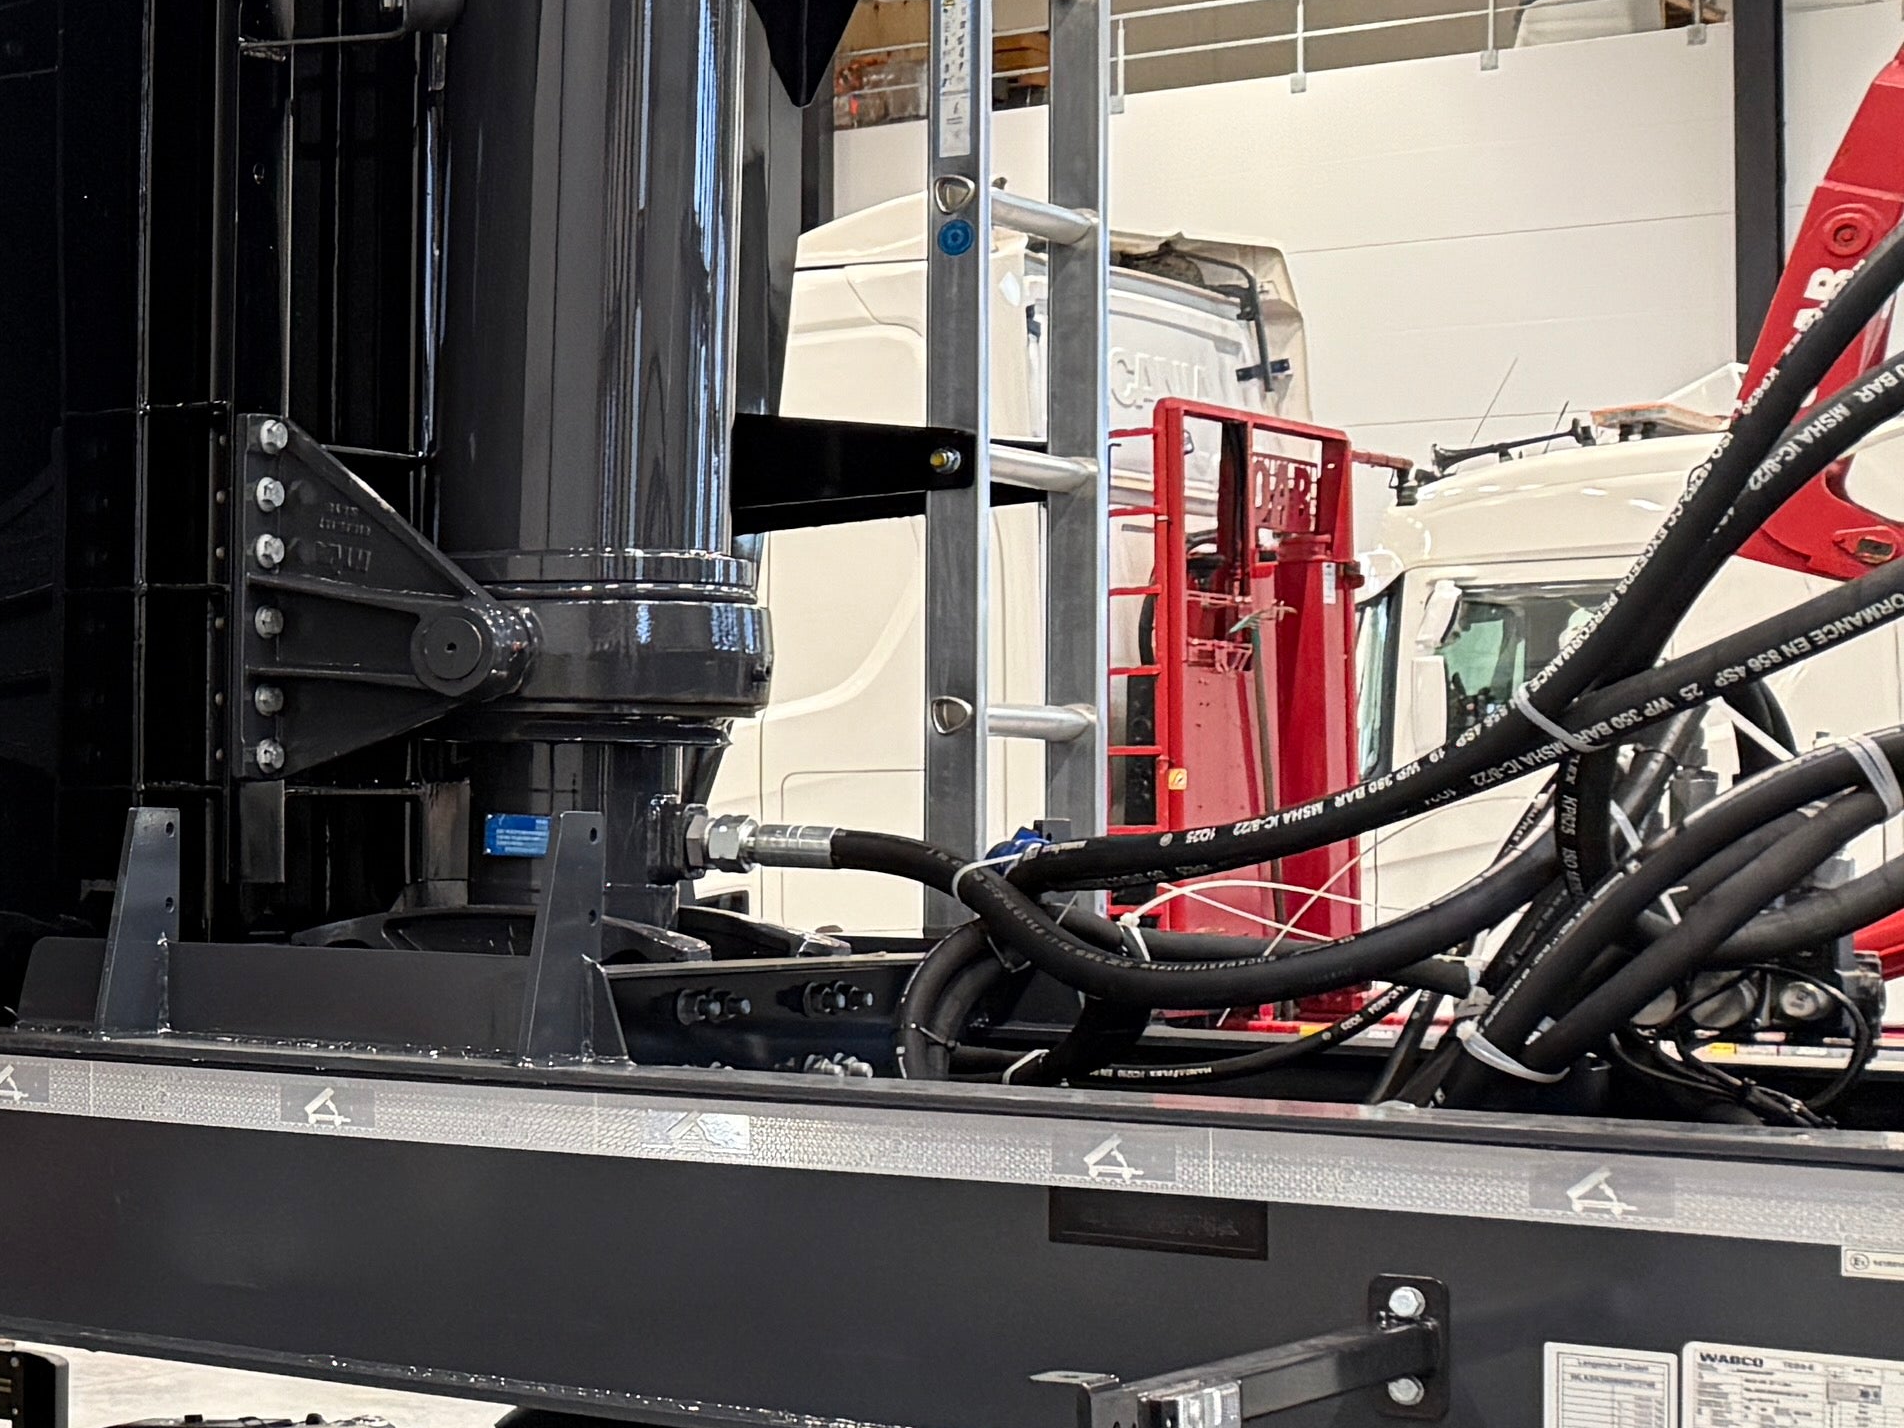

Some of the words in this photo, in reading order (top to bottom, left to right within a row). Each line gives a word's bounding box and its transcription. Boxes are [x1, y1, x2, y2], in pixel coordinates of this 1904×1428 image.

[1796, 402, 1852, 446] MSHA
[1782, 632, 1811, 657] EN
[1746, 647, 1782, 675] 856
[1713, 662, 1747, 689] 4SP
[1679, 680, 1704, 703] 25
[1613, 704, 1641, 731] 350
[1640, 694, 1675, 721] WP
[1519, 727, 1568, 765] MSHA
[1333, 778, 1367, 808] BAR
[1281, 801, 1325, 827] MSHA
[1699, 1351, 1764, 1368] WABCO
